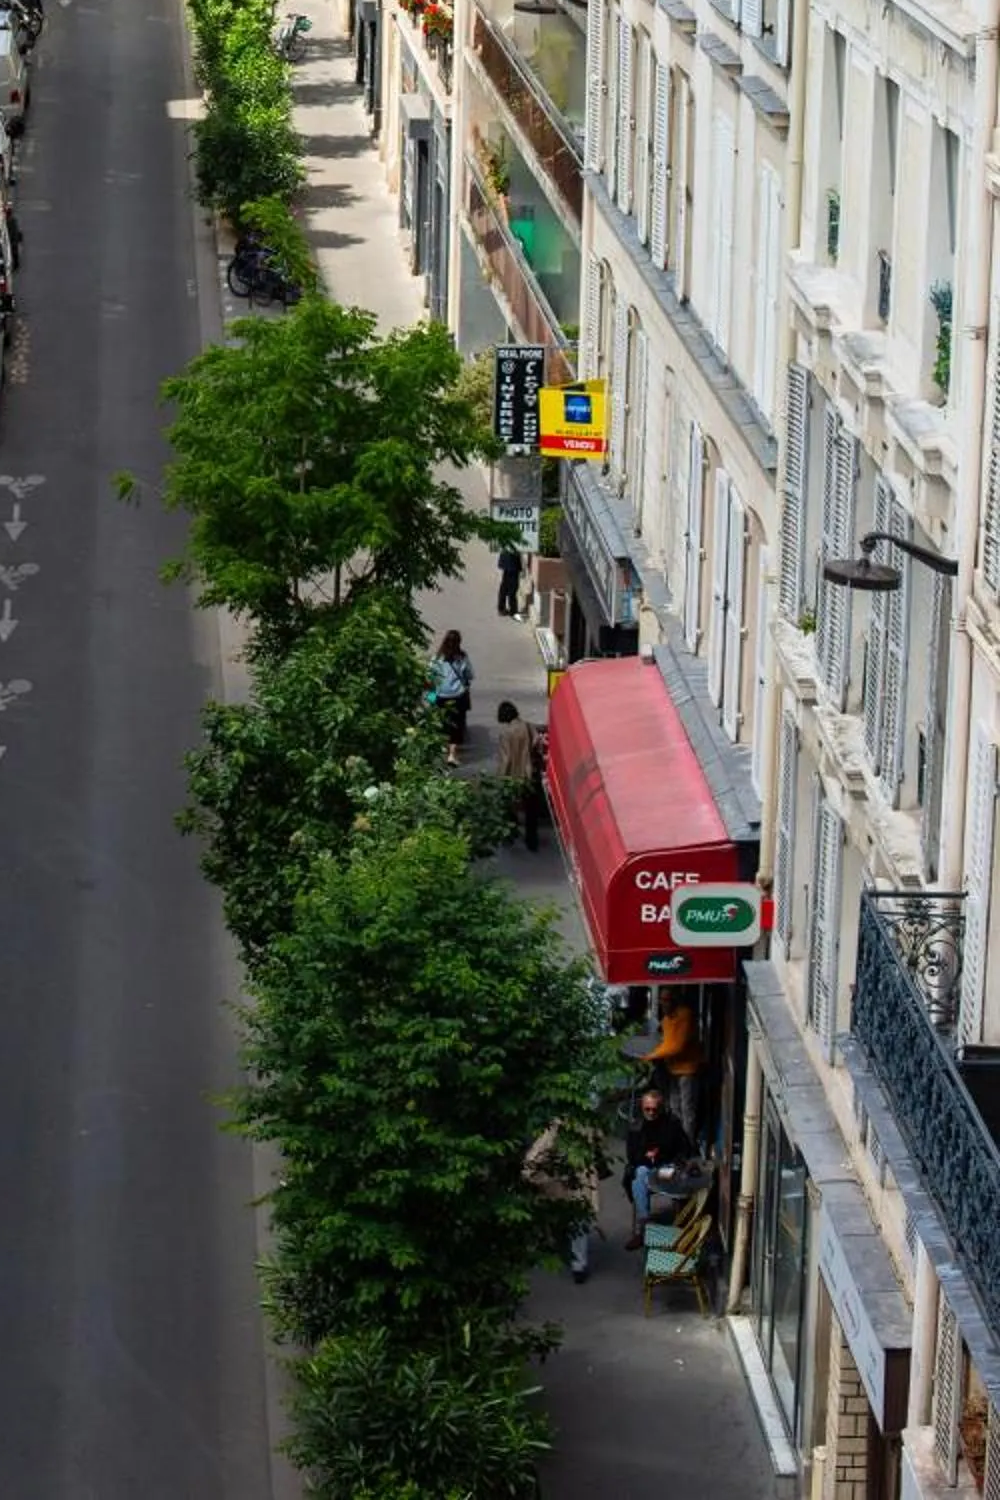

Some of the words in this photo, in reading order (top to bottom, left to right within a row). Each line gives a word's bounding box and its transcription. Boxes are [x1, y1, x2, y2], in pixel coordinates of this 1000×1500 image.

[499, 506, 533, 518] PHOTO
[641, 904, 672, 923] BA
[685, 908, 721, 923] PMU
